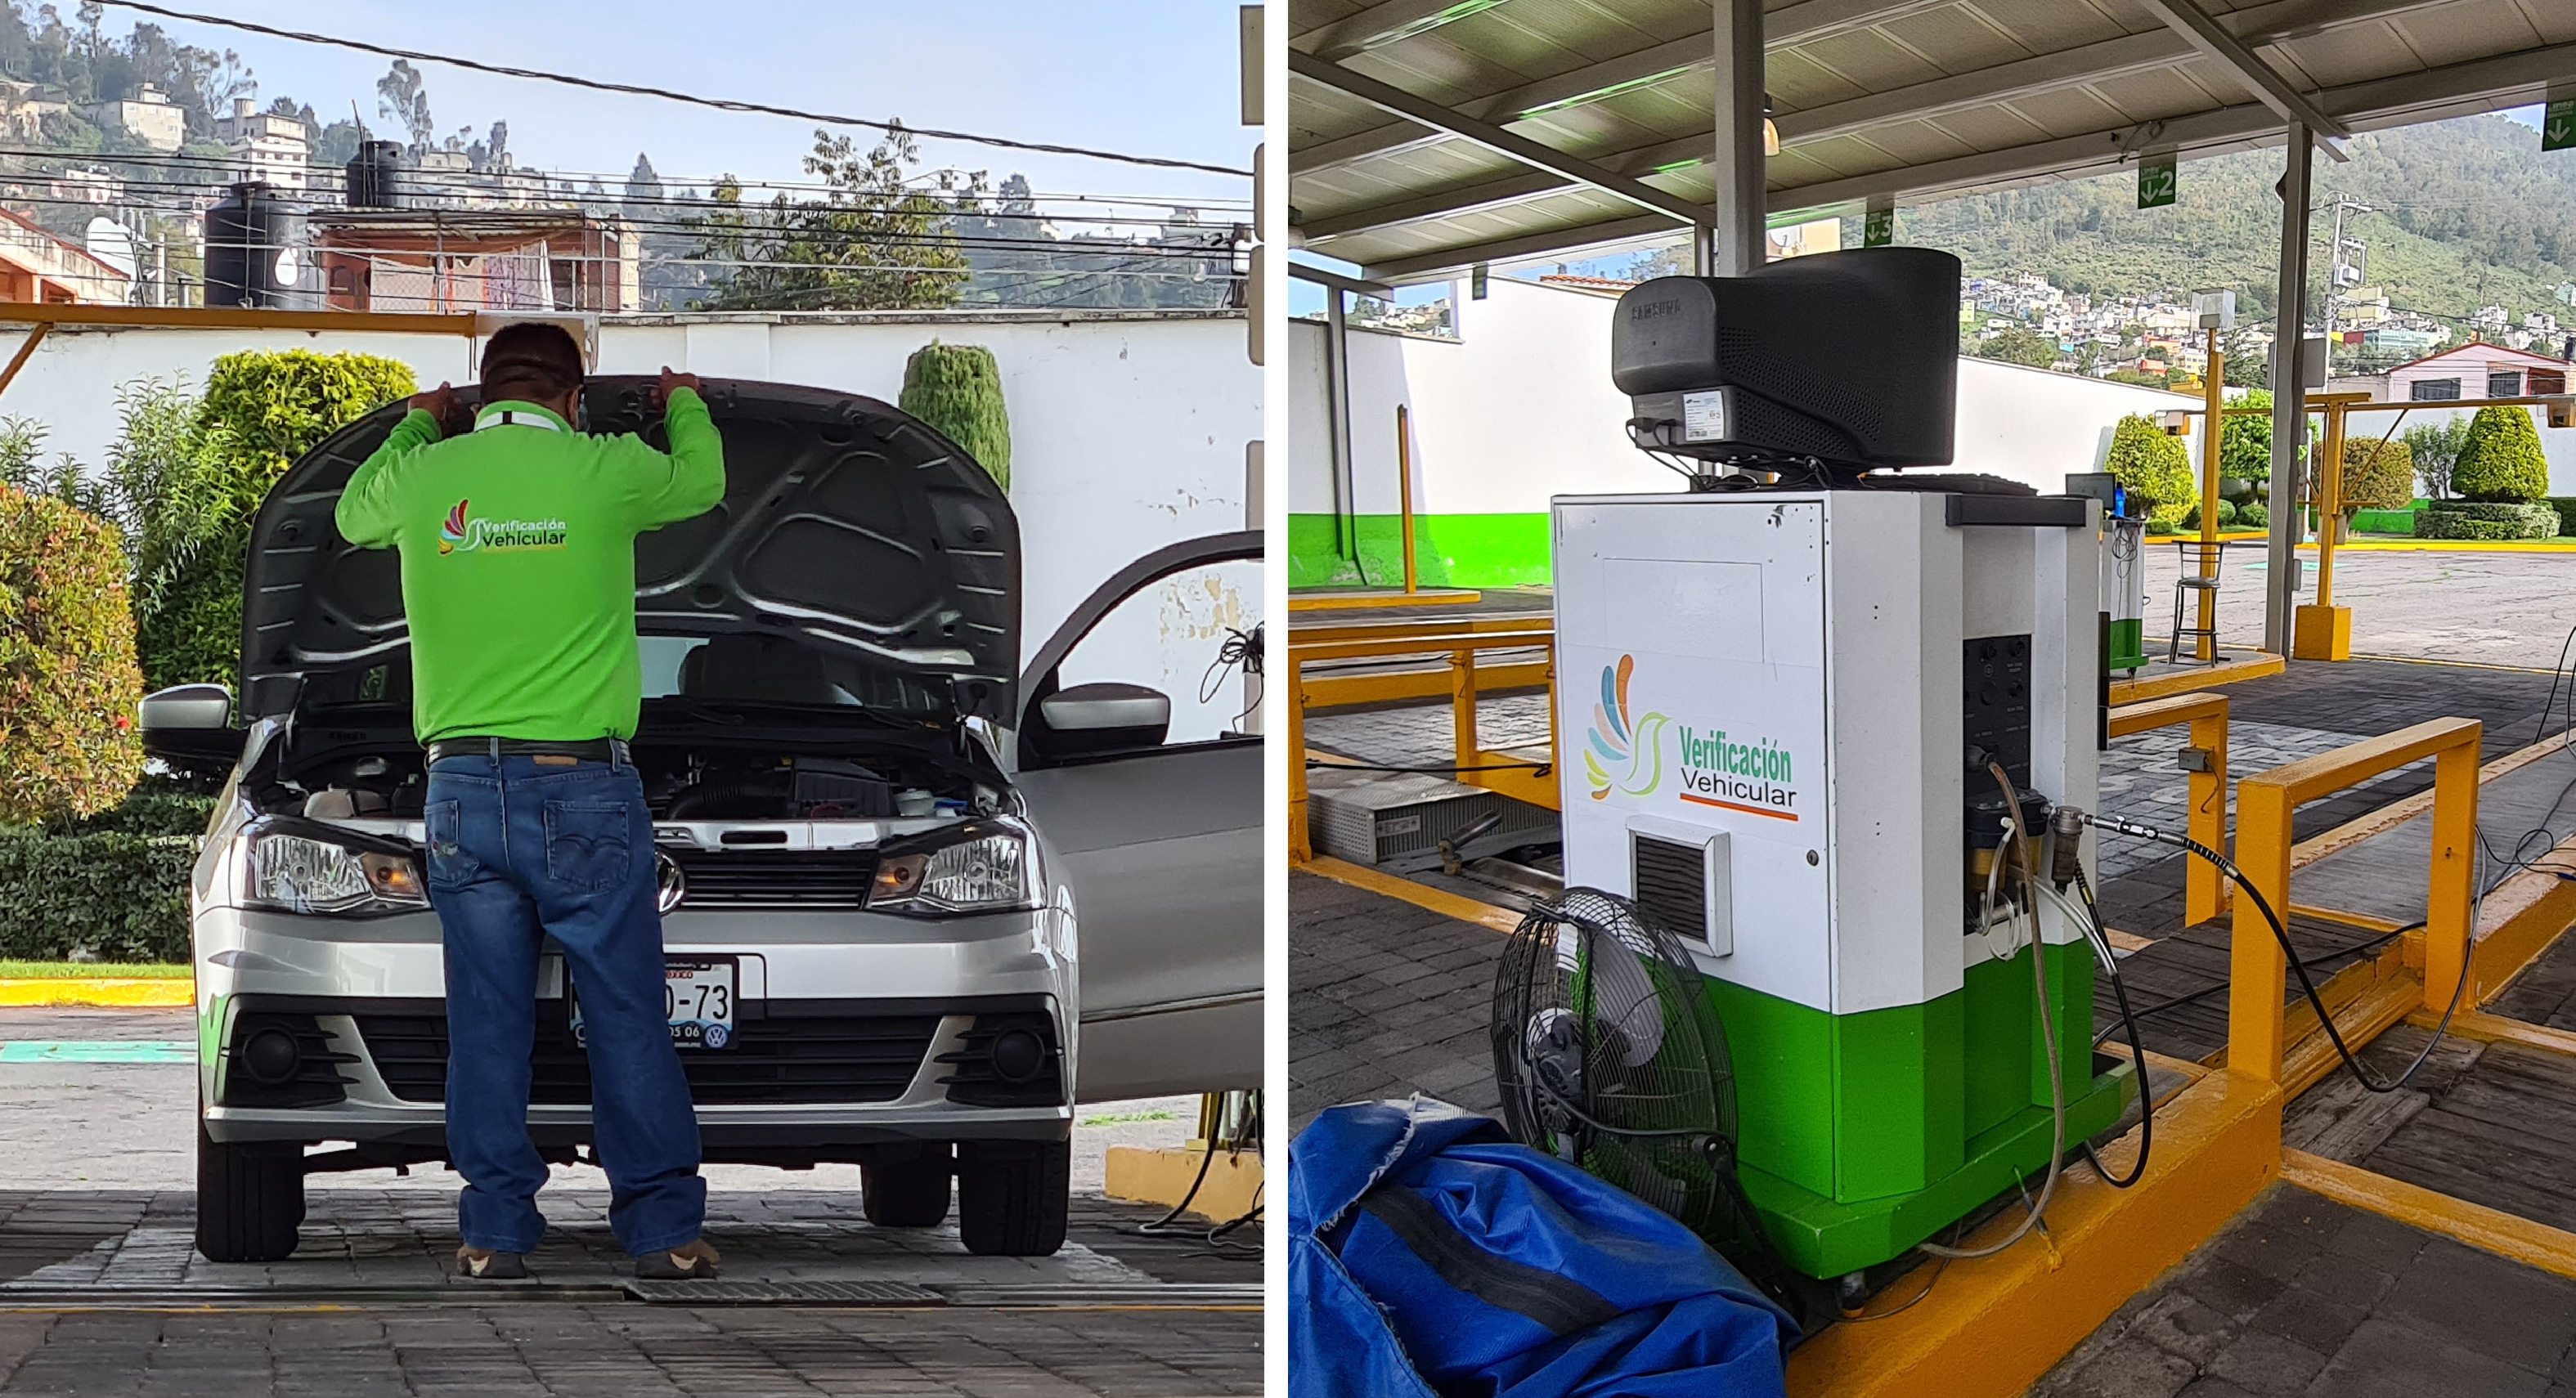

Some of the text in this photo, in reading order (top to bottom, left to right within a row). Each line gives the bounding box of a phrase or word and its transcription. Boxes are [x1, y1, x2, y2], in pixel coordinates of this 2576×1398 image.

[2158, 171, 2174, 196] 2
[1880, 215, 1892, 237] 3
[1631, 298, 1681, 321] SAMSUNG
[483, 518, 566, 533] Verificación
[483, 530, 567, 547] Vehicular
[1679, 725, 1792, 783] Verificación
[1681, 768, 1797, 808] Vehicular
[684, 1025, 700, 1038] 06
